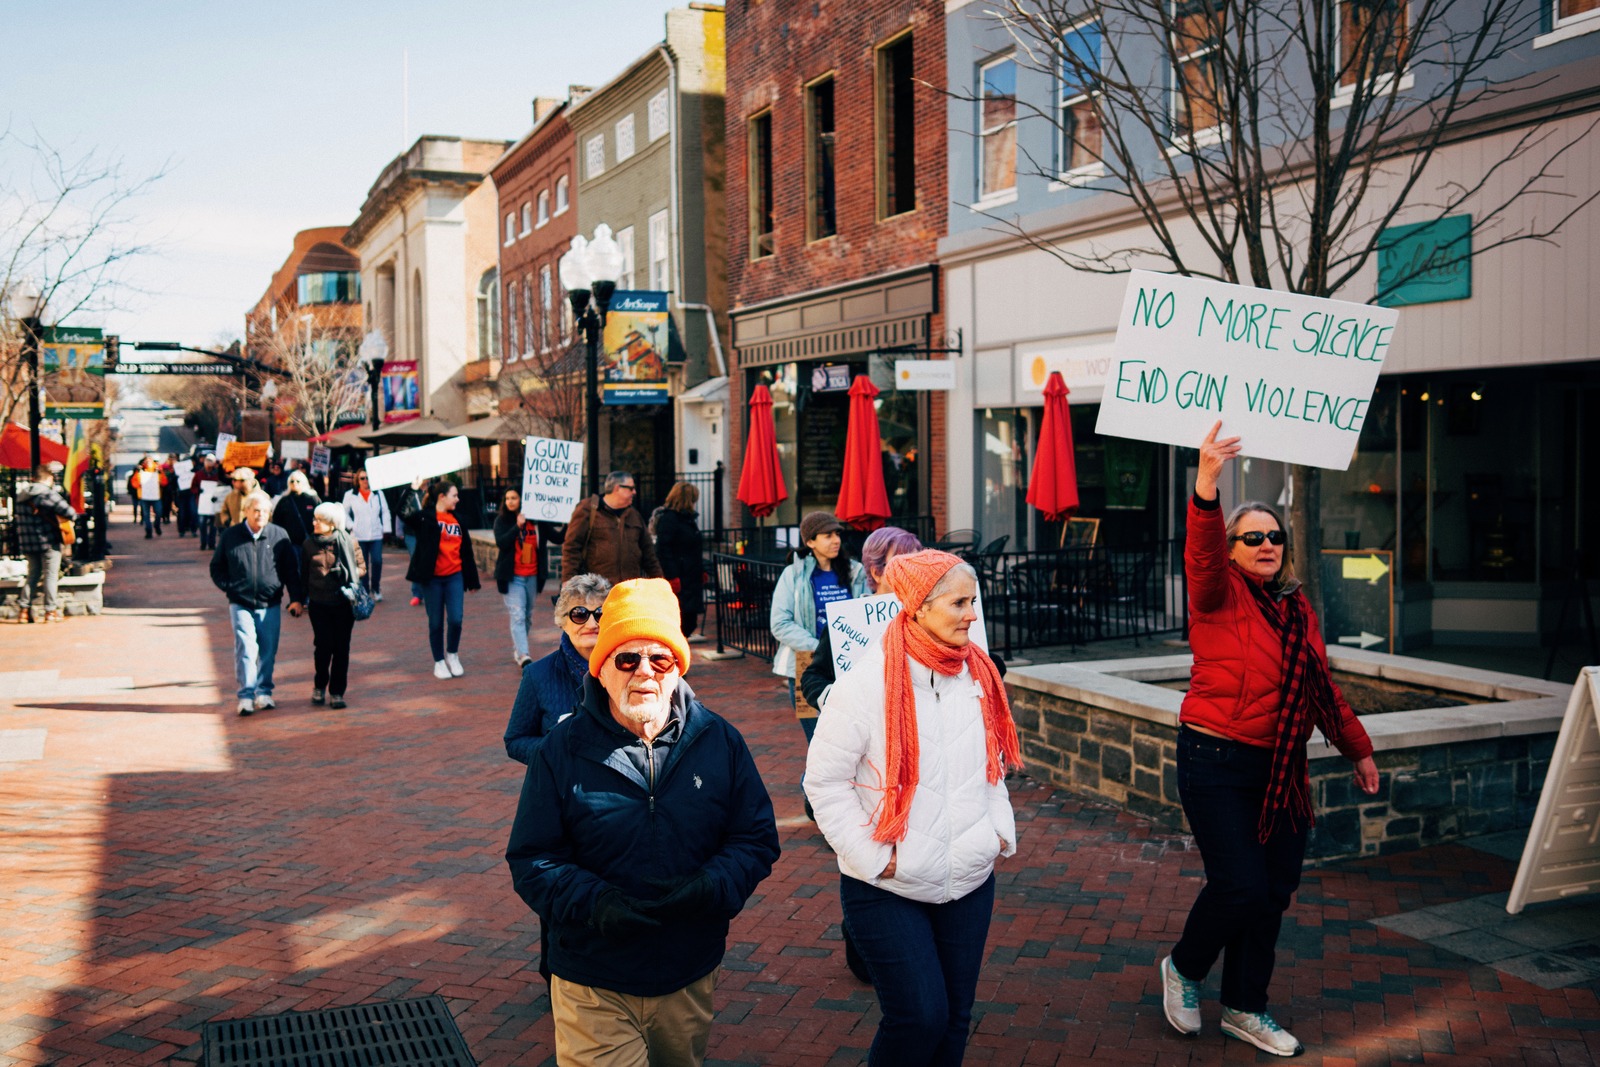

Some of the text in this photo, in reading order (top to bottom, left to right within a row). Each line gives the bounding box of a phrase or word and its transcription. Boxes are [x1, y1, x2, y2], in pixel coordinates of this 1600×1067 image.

[1132, 287, 1394, 362] NO MORE SILENCE
[115, 363, 234, 374] OLD TOWN WINCHESTER
[1116, 360, 1369, 432] END GUN VIOLENCE
[534, 439, 570, 460] GUN
[526, 457, 580, 476] VIOLENCE
[528, 473, 569, 488] IS OVER
[524, 492, 574, 505] IF YOU WANT IT
[831, 615, 870, 647] ENOUGH
[841, 640, 852, 652] IS
[836, 653, 852, 672] EN
